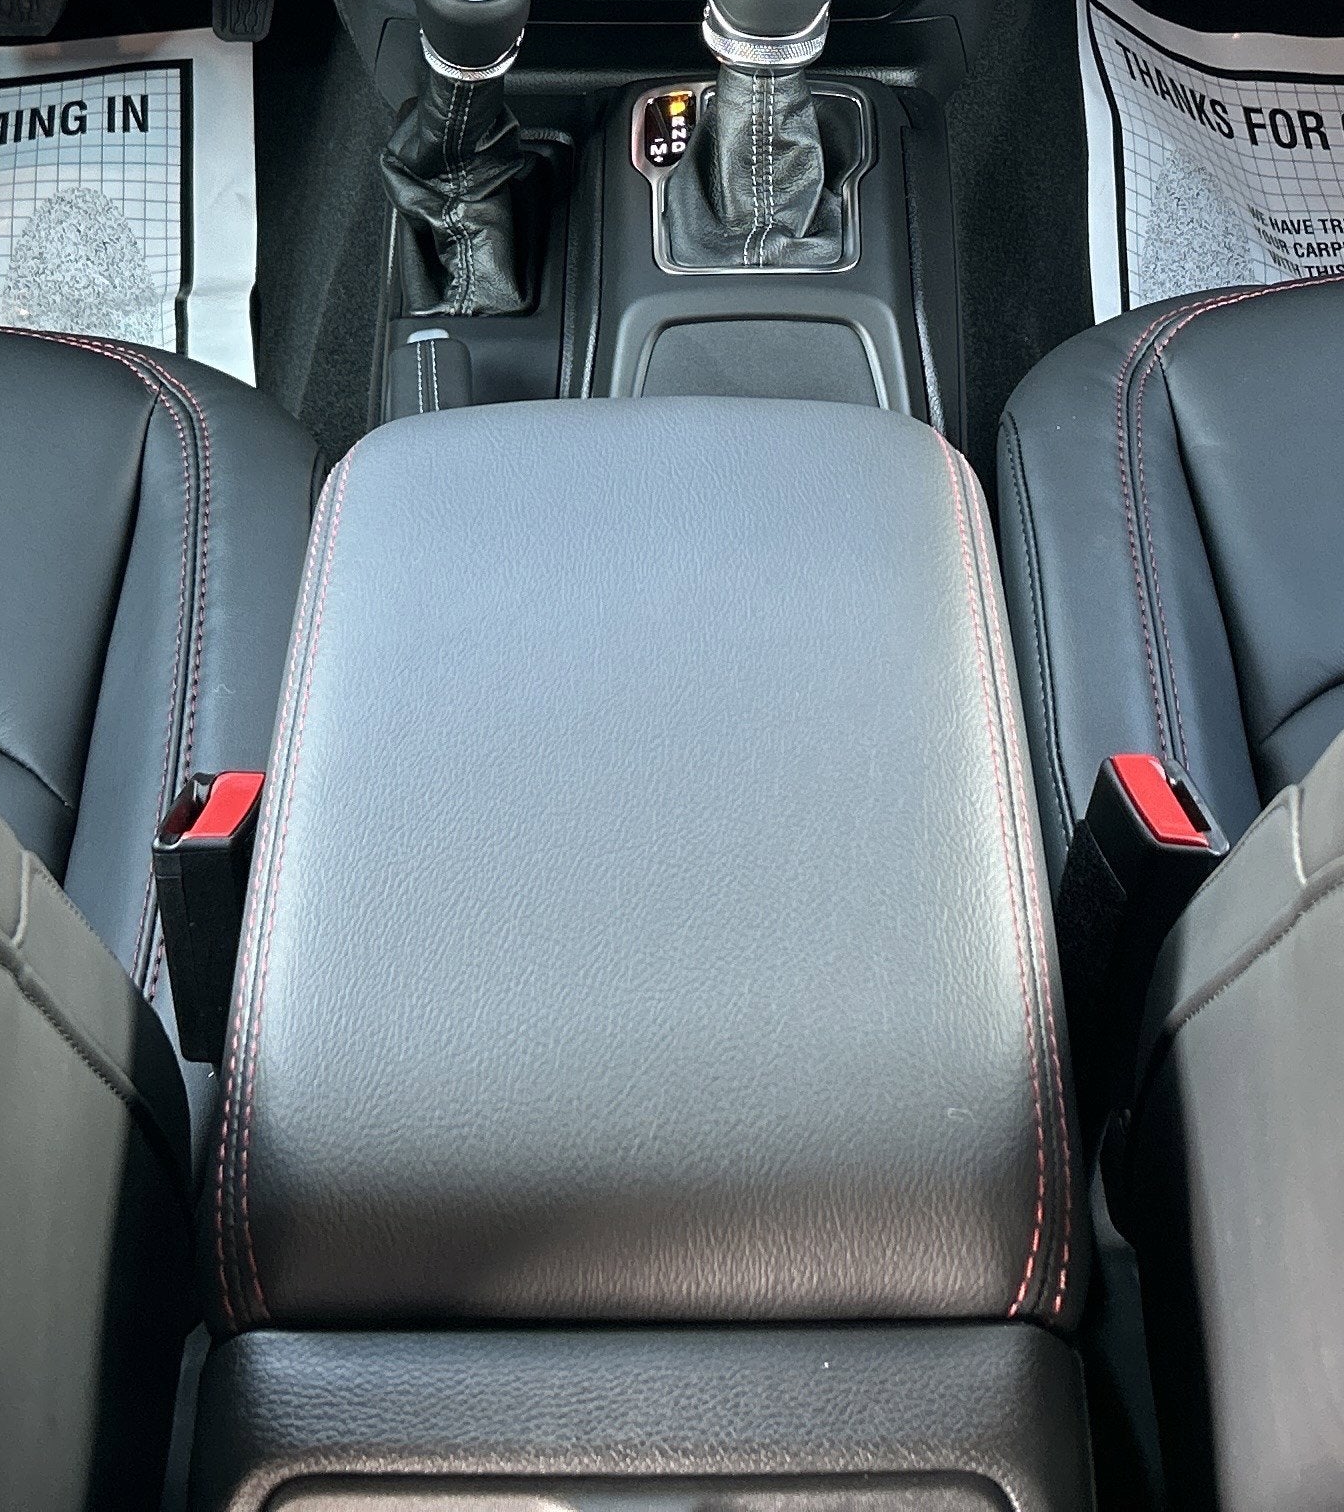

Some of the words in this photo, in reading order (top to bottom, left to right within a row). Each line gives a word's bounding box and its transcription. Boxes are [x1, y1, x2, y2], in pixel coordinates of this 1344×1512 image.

[1113, 38, 1235, 139] THANKS
[1242, 105, 1331, 150] FOR
[106, 94, 149, 134] IN
[671, 116, 687, 128] R
[671, 128, 687, 140] N
[650, 143, 668, 156] M
[671, 141, 687, 154] D
[1268, 216, 1315, 235] HAVE
